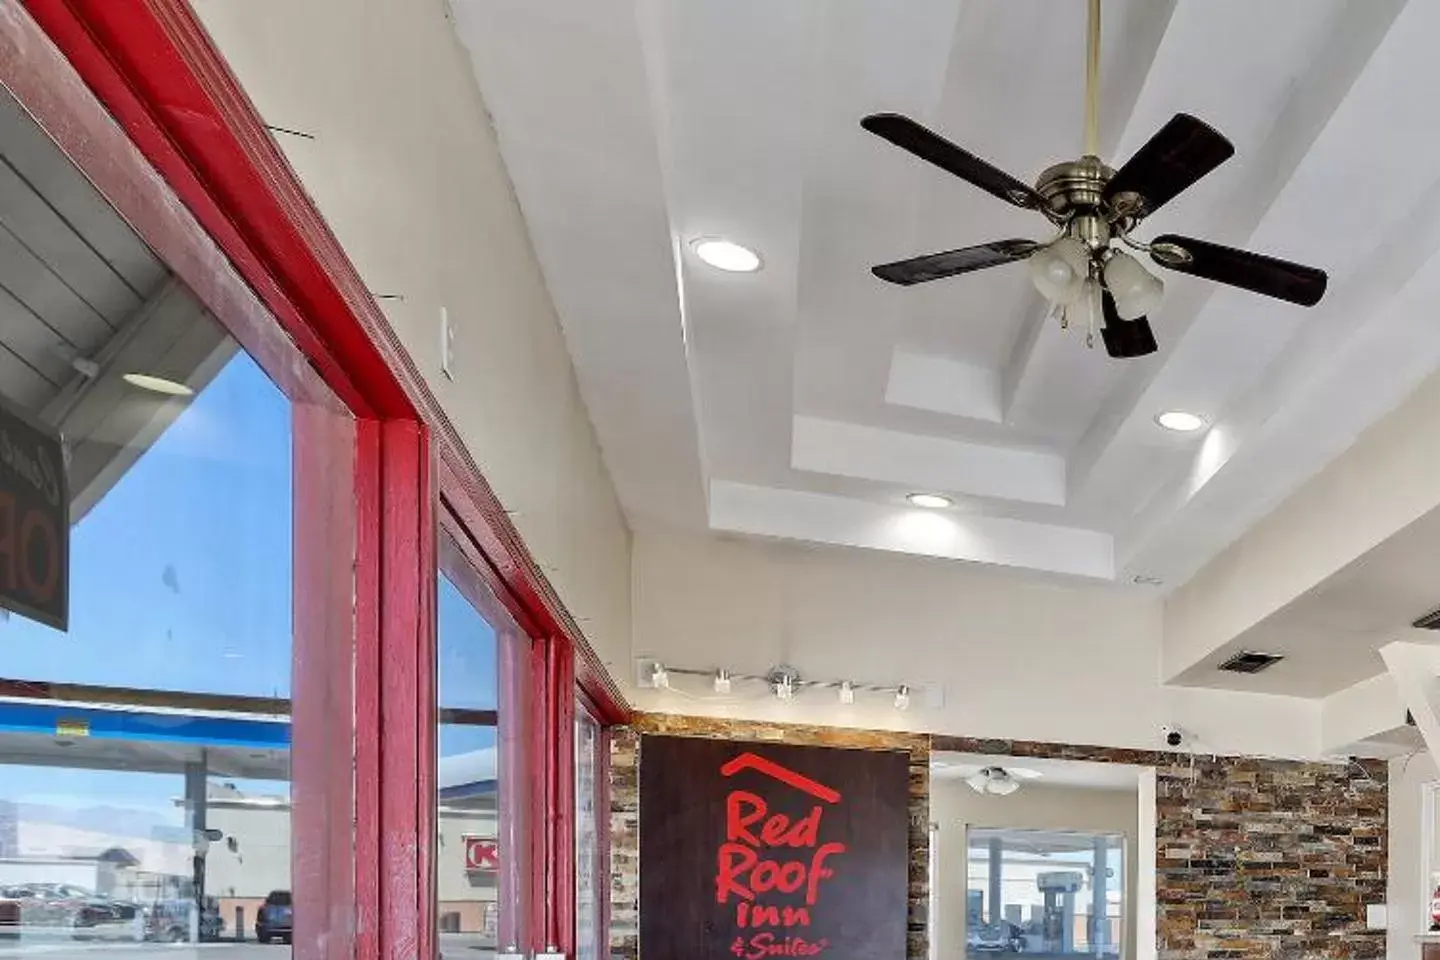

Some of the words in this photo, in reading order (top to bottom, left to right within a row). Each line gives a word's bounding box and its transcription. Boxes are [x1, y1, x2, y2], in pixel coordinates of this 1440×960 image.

[727, 790, 823, 847] Red
[715, 842, 846, 905] Roof
[730, 936, 745, 957] &
